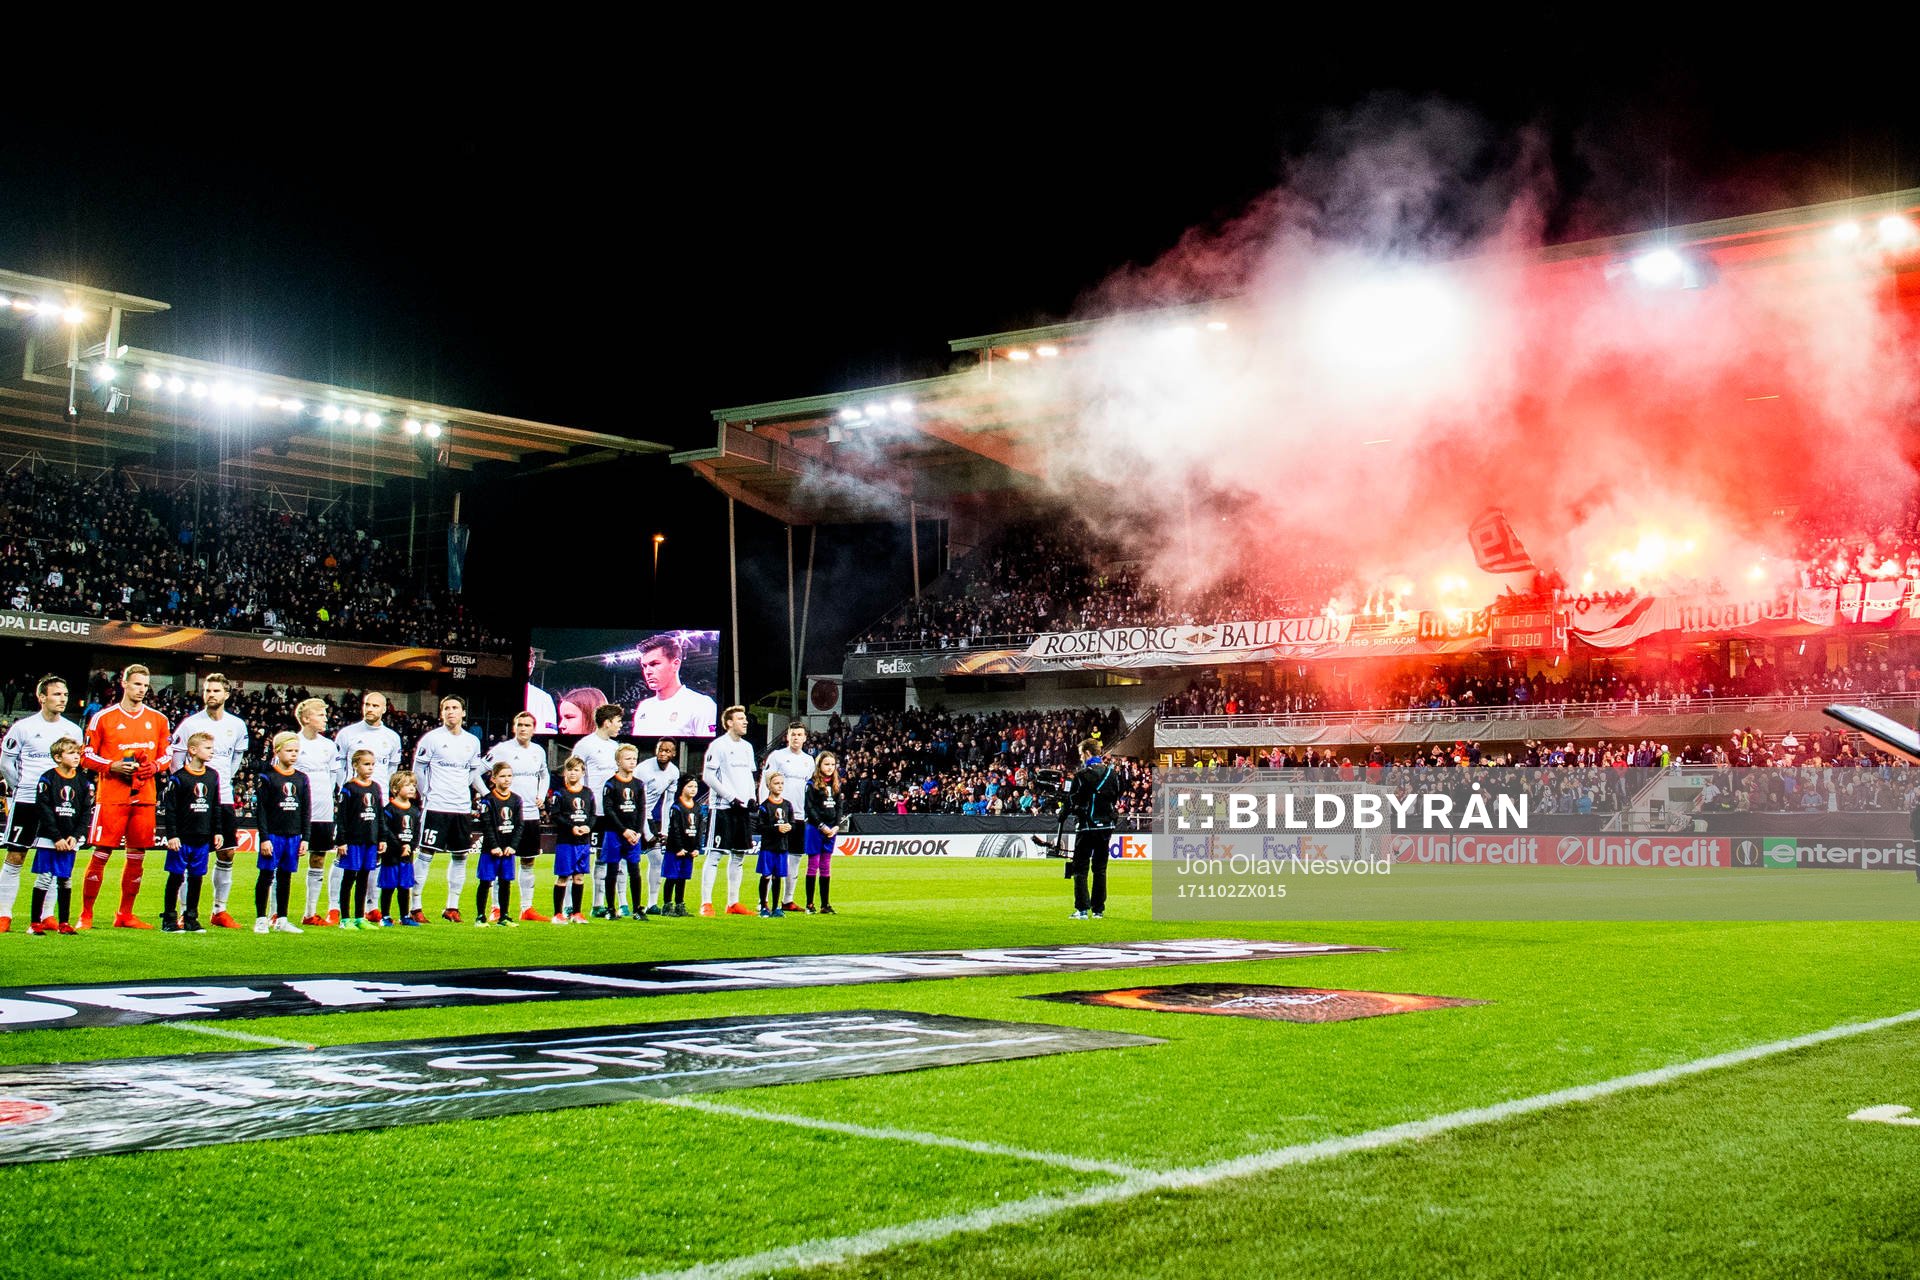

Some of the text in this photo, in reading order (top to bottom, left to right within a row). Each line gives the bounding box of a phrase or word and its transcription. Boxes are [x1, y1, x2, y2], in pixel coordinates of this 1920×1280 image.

[29, 617, 91, 635] LEAGUE
[1043, 617, 1341, 655] ROSENBORG BALLKLUB
[276, 640, 327, 657] UniCredit
[876, 659, 911, 674] FedEx
[13, 825, 23, 842] 7
[96, 826, 103, 842] 1
[424, 828, 438, 845] 15
[714, 835, 721, 848] 9
[858, 839, 950, 856] HANKOOK
[1109, 835, 1147, 858] dEx
[1172, 836, 1329, 860] FedEx FedEx
[1418, 837, 1539, 865] UniCredit
[1586, 838, 1720, 867] UniCredit
[1763, 842, 1915, 869] enterpris
